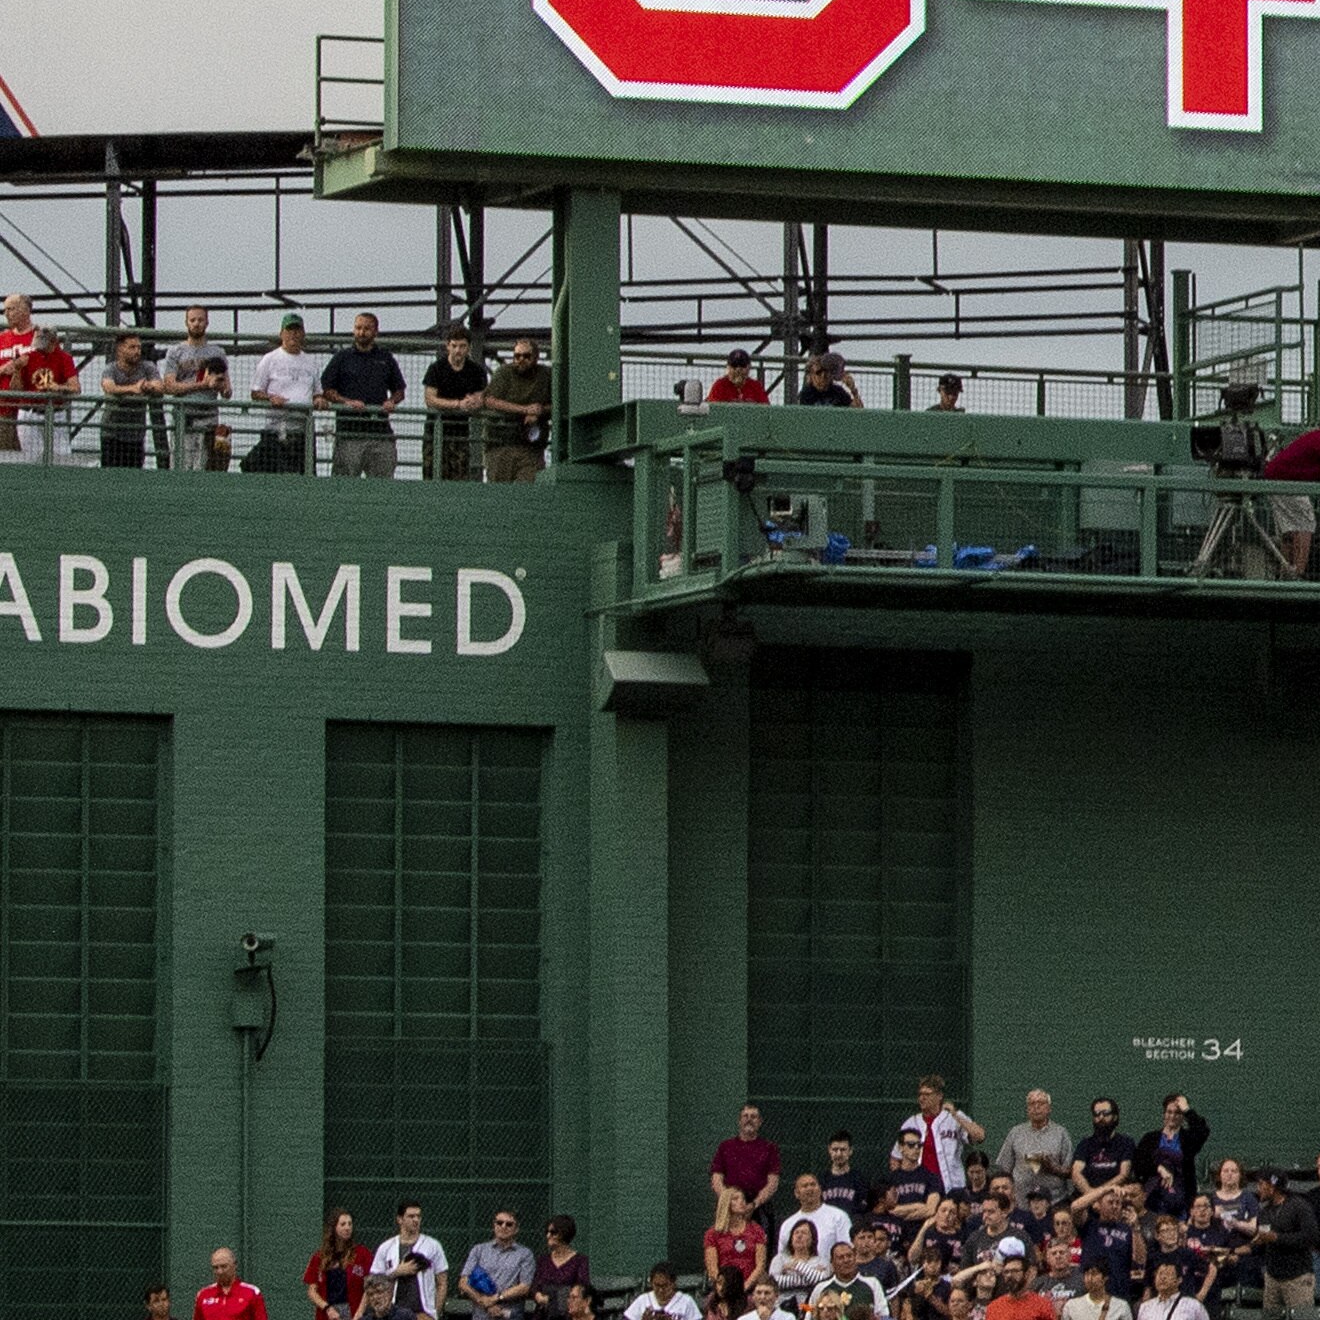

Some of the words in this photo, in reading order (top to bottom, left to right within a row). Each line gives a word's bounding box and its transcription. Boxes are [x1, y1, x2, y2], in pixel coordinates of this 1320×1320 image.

[1132, 1037, 1195, 1049] BLEACHER
[1145, 1049, 1195, 1060] SECTION
[1201, 1038, 1244, 1061] 34
